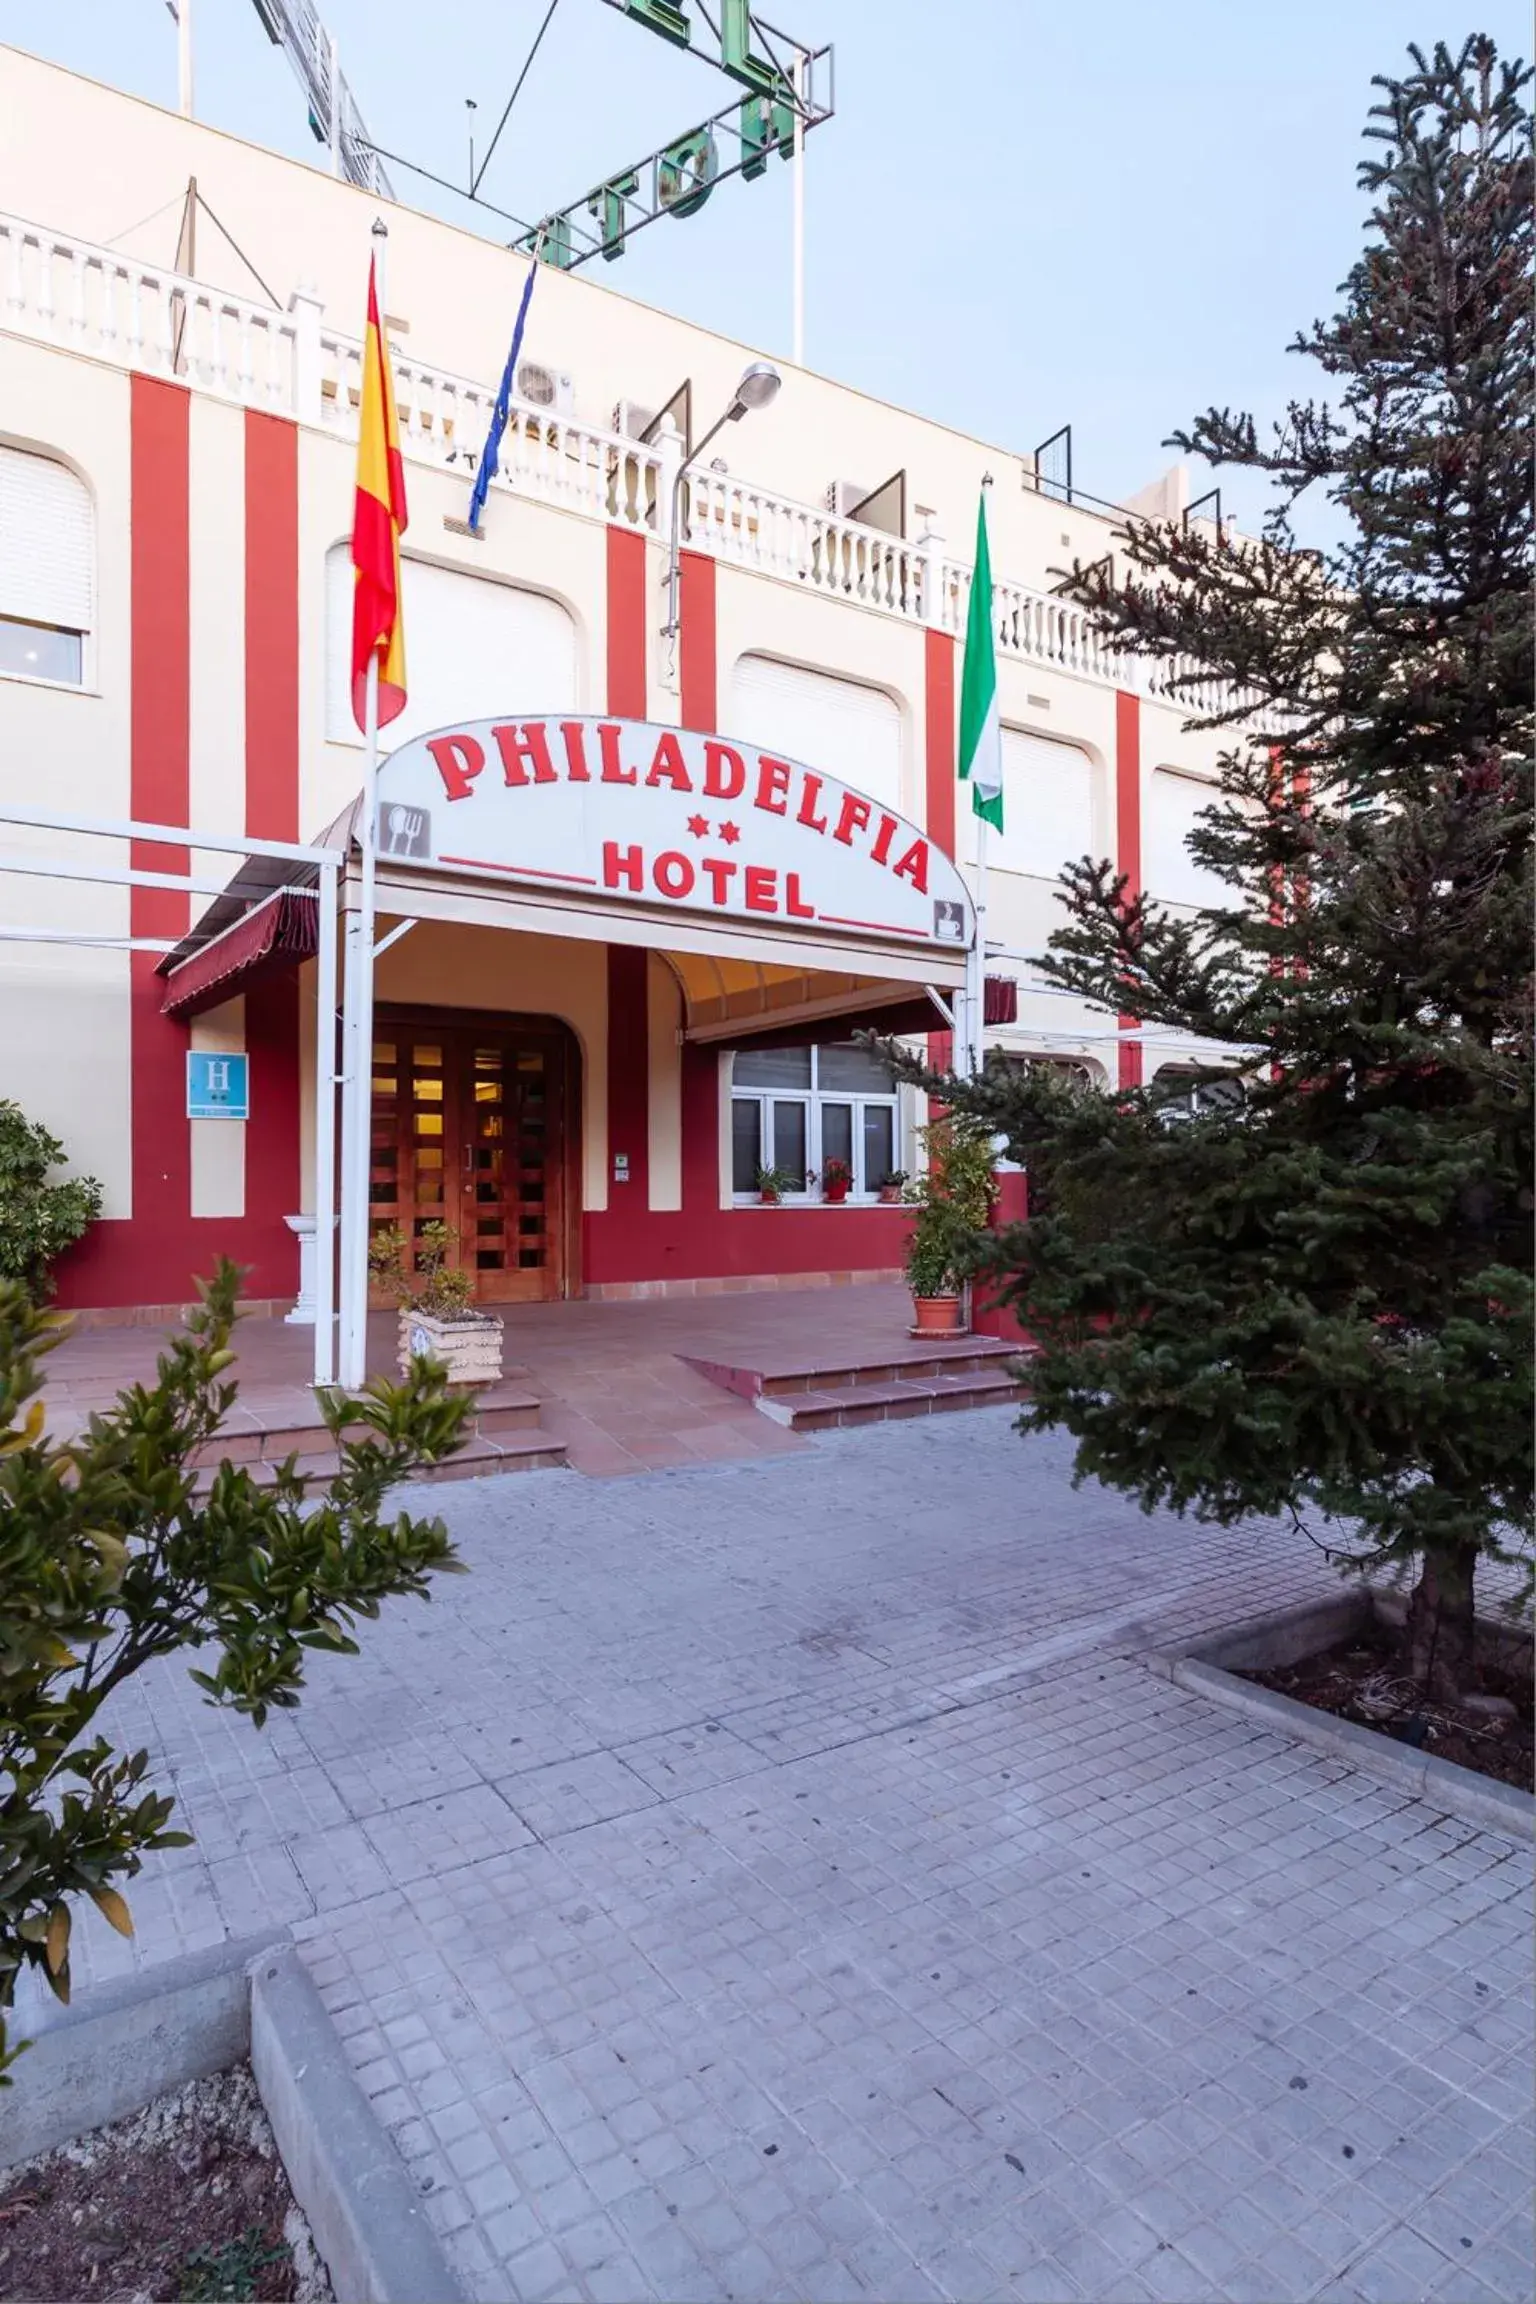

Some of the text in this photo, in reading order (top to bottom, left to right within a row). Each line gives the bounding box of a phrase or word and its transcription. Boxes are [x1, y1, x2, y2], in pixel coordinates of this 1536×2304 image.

[426, 721, 929, 895] PHILADELFIA
[602, 839, 815, 919] HOTEL
[206, 1060, 231, 1090] H
